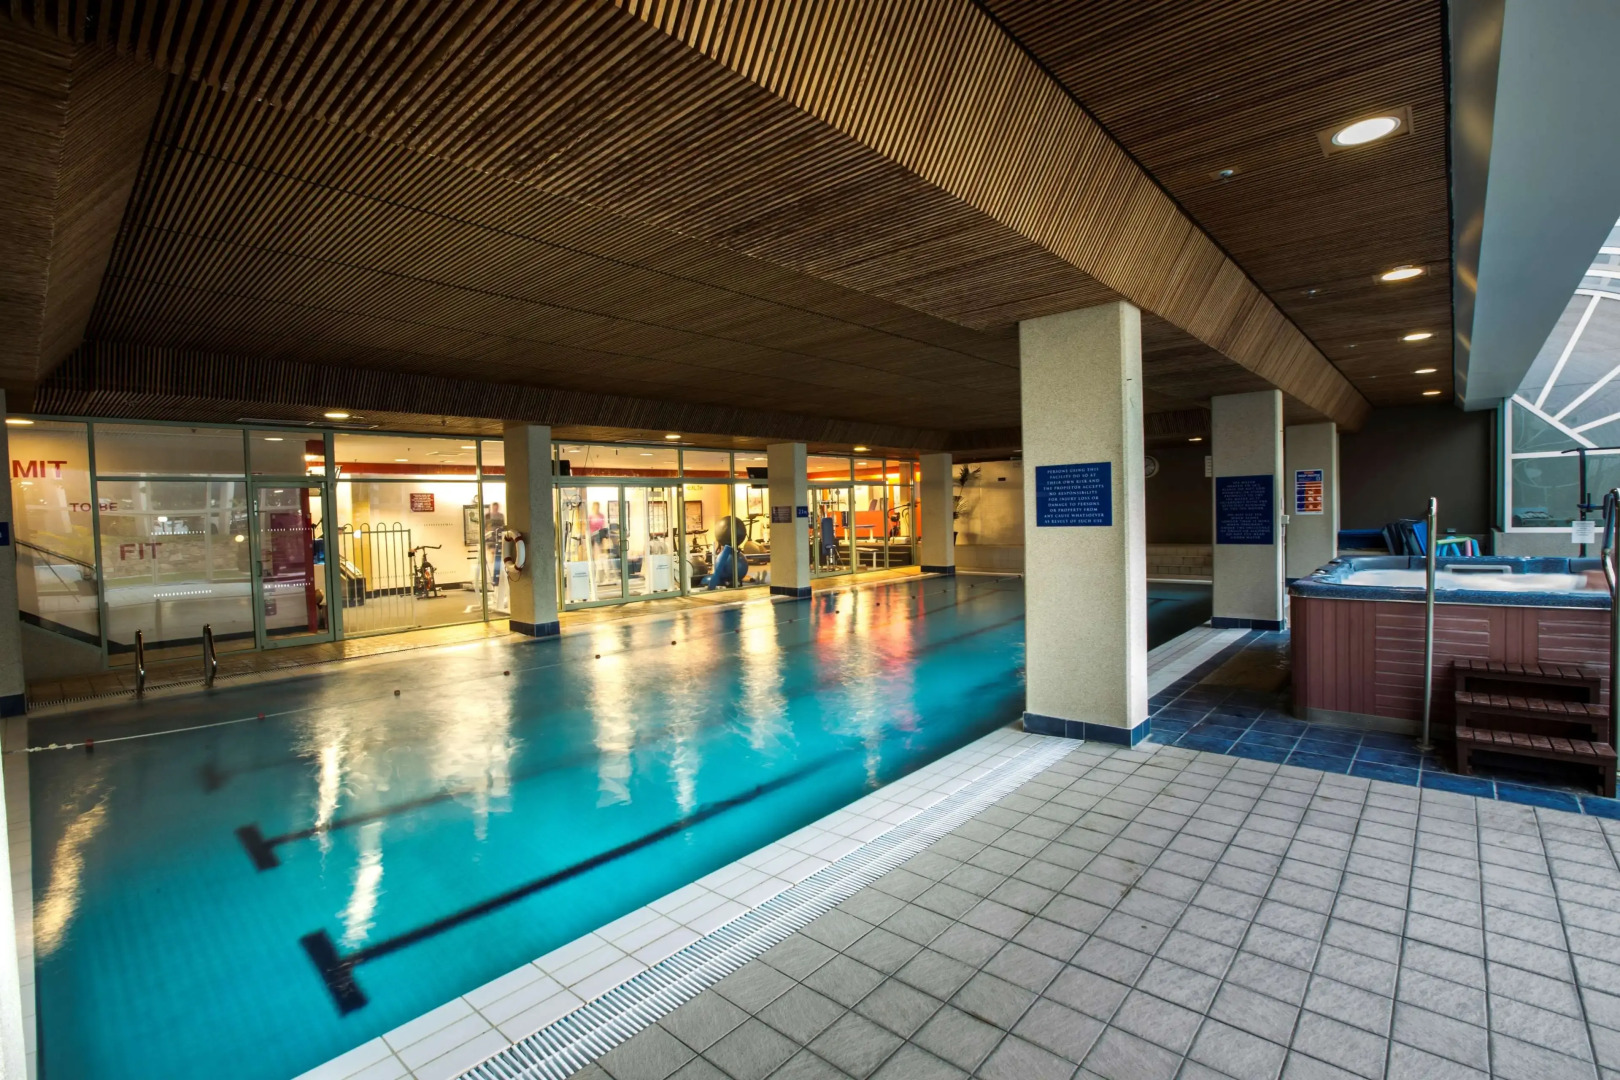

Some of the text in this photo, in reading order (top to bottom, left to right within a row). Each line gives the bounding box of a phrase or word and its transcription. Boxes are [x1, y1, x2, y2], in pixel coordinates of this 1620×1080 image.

[12, 460, 67, 478] MIT
[70, 503, 118, 512] TO BE
[120, 543, 162, 560] FIT
